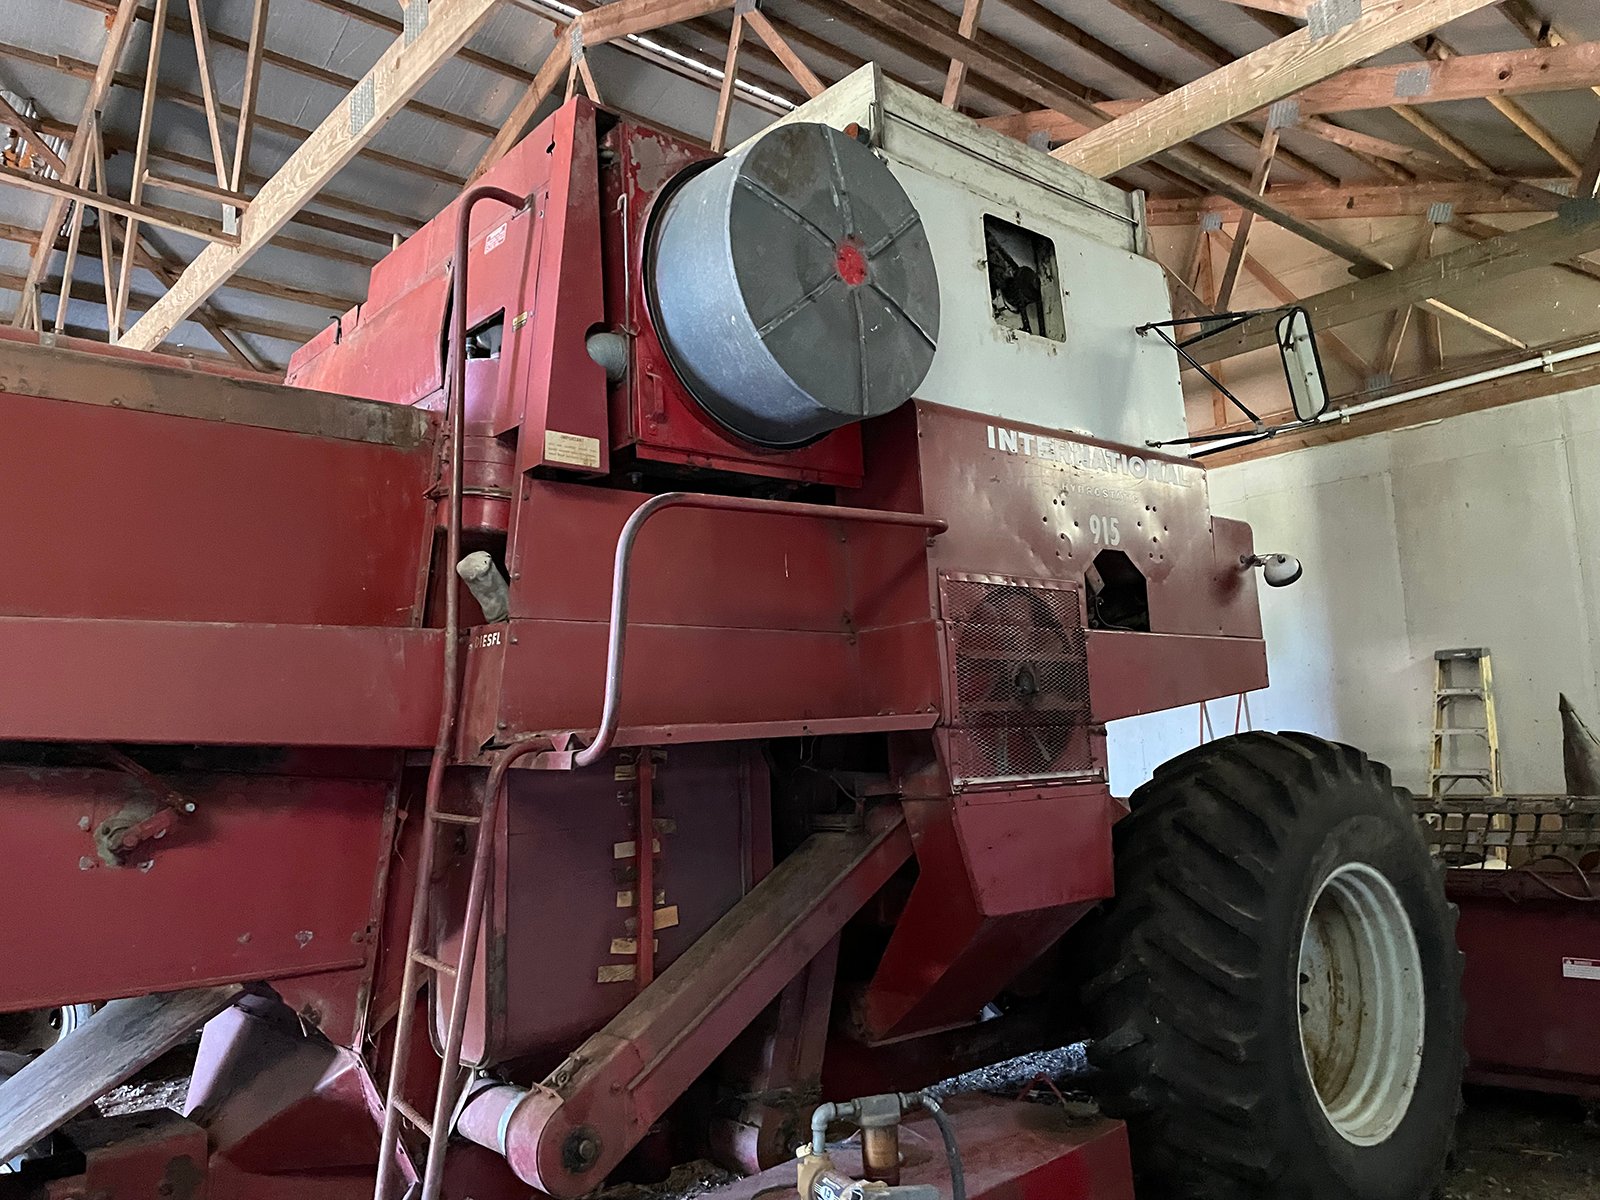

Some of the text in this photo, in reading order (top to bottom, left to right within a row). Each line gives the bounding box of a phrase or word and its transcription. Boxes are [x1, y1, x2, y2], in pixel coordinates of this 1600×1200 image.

[986, 425, 1191, 487] INTERNATIONAL
[1062, 483, 1138, 503] HYDROSTAC
[1089, 514, 1121, 546] 915
